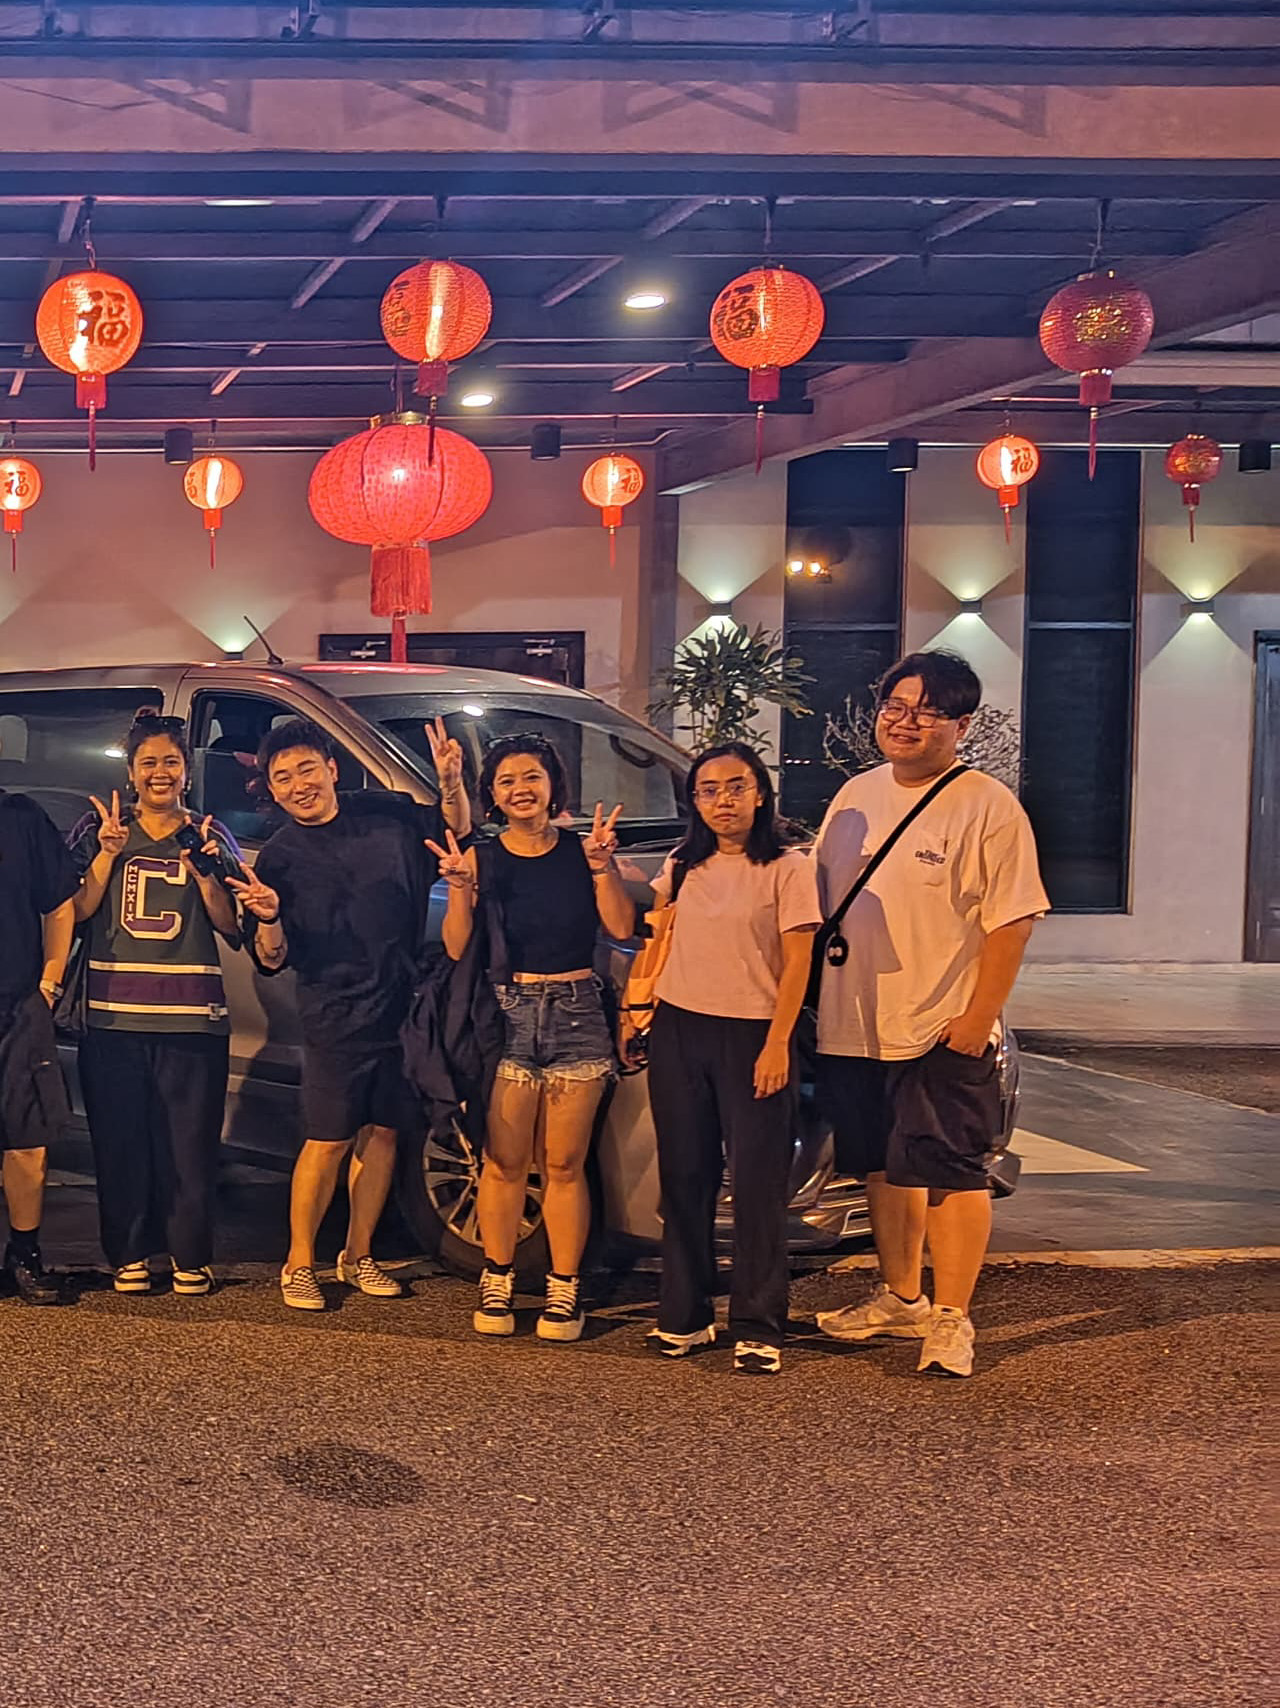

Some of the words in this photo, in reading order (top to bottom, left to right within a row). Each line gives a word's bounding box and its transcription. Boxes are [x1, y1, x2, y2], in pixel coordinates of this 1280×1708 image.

[78, 290, 129, 347] 福
[715, 283, 759, 340] 福
[4, 470, 29, 497] 福
[621, 467, 641, 494] 福
[1011, 447, 1033, 475] 福
[121, 855, 187, 941] C
[125, 865, 138, 922] MCMXIX
